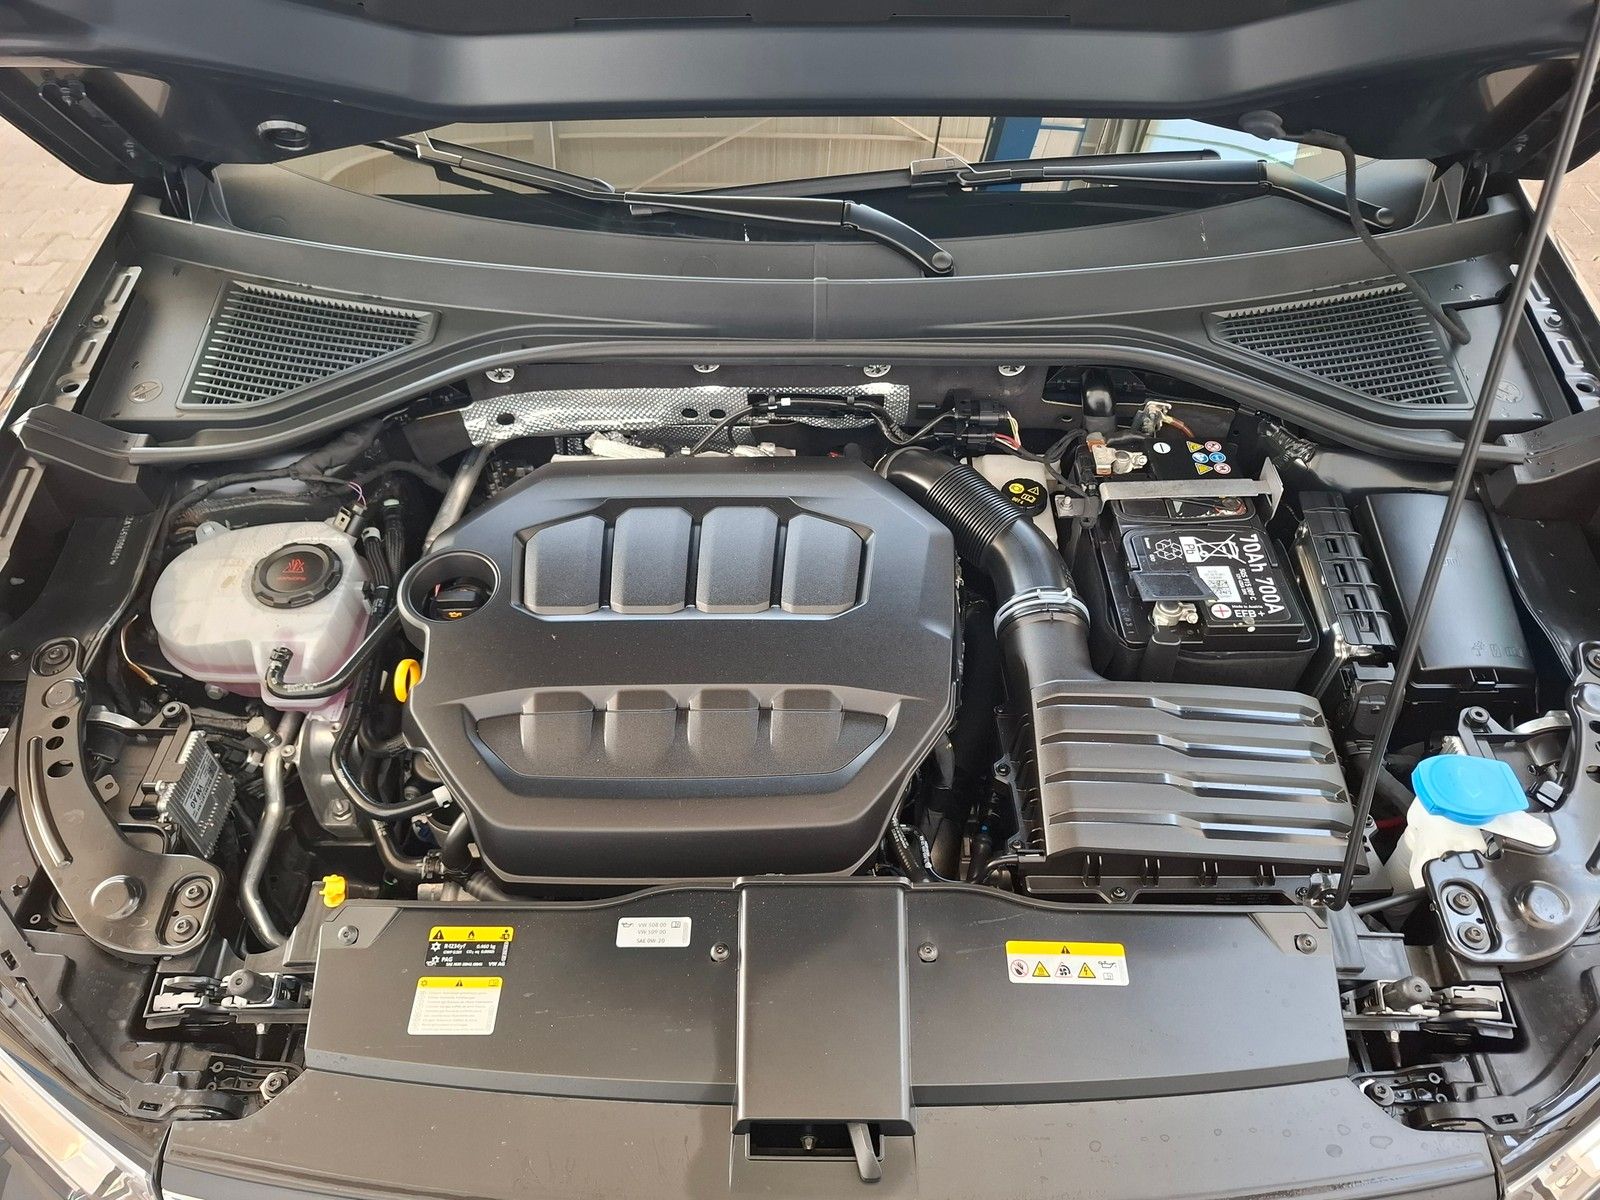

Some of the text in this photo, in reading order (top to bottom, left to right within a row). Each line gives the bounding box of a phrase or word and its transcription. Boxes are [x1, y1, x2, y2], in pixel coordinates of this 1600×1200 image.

[1184, 544, 1196, 555] Pb
[1240, 533, 1285, 614] 70Ah 700A
[1234, 610, 1257, 618] EFB
